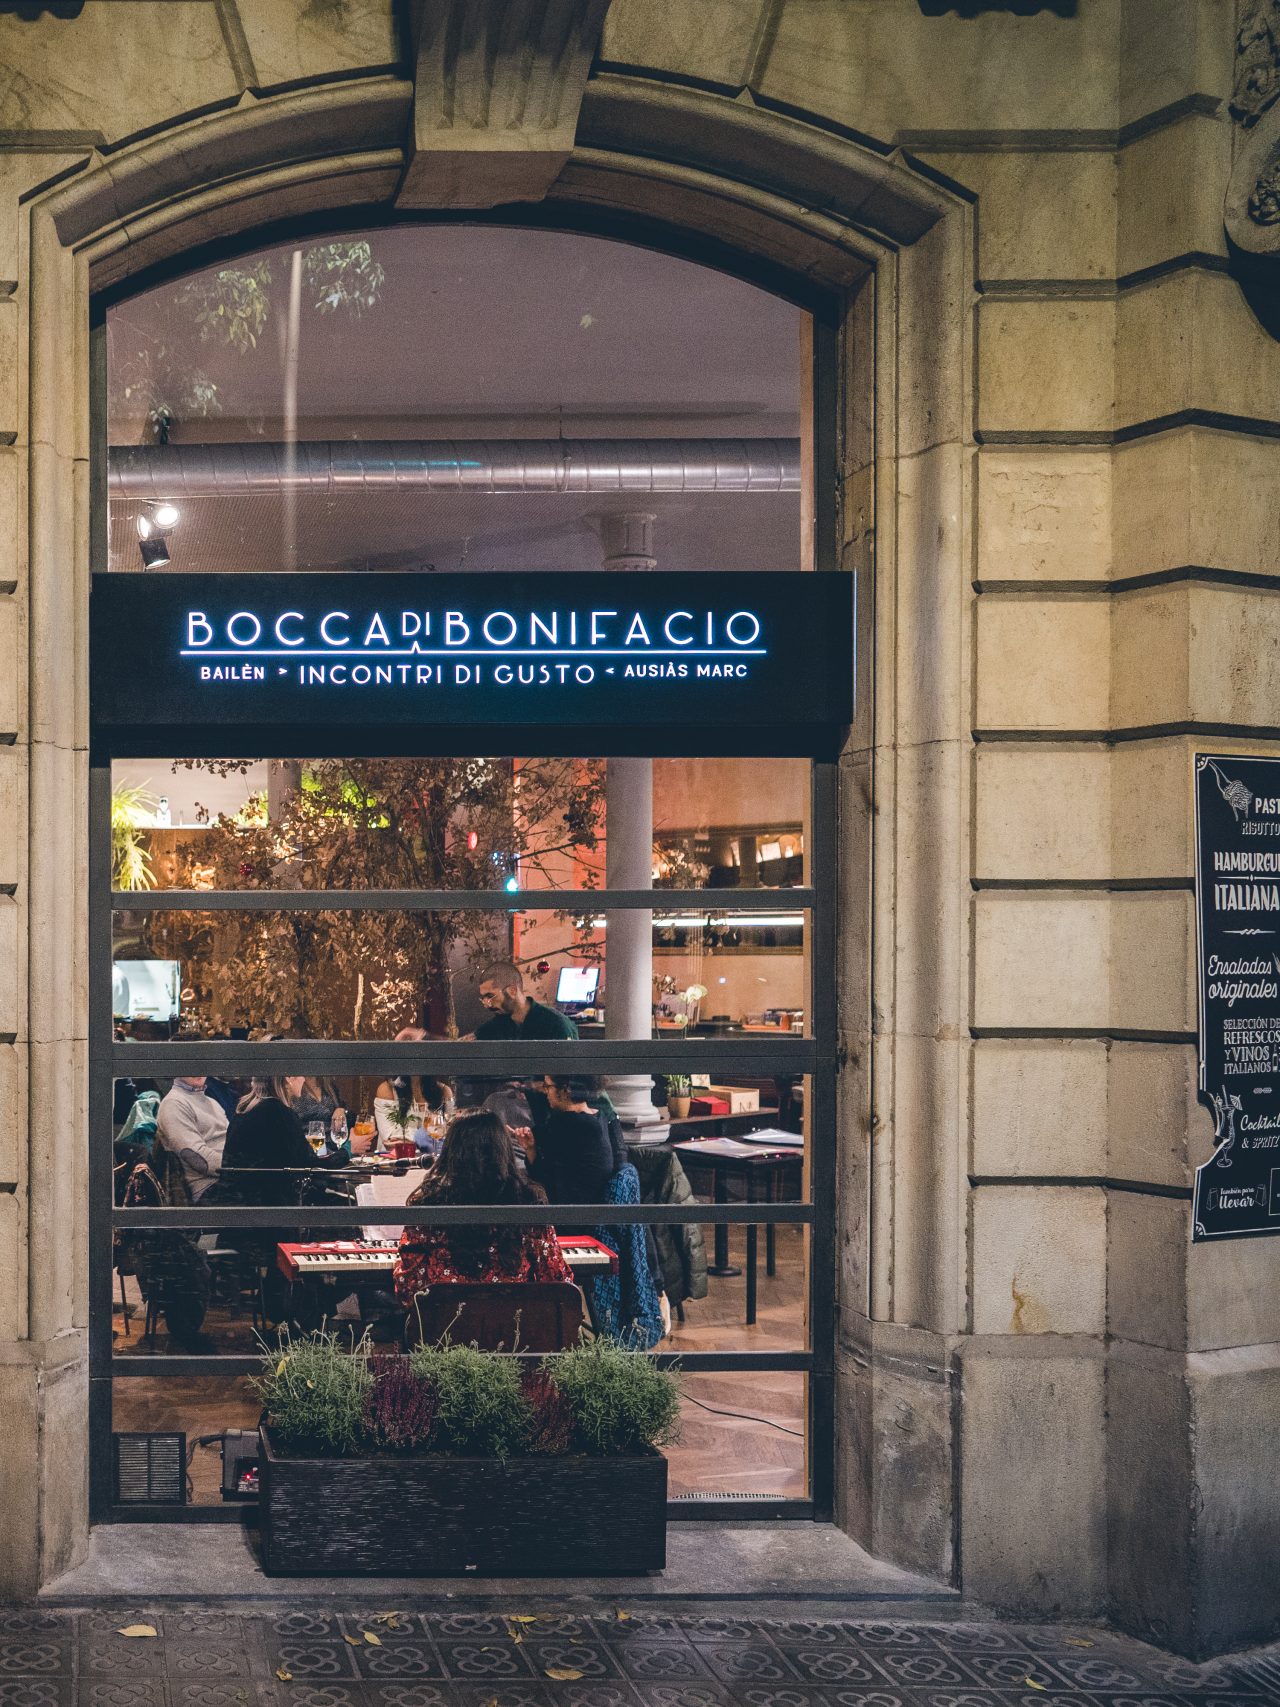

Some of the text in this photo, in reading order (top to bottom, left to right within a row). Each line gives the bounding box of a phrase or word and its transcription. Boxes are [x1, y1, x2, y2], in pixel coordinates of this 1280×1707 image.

[187, 611, 760, 646] BOCCA DI BONIFACIO
[200, 661, 748, 685] BAILÈN INCONTRI DI GUSTO AUSIÀS MARC
[1214, 884, 1280, 911] ITALIANA
[1208, 954, 1272, 977] Ensaladas
[1208, 979, 1278, 1008] originales
[1223, 1016, 1268, 1030] SELECCIÓN
[1223, 1030, 1280, 1045] REFRESCOS
[1231, 1046, 1270, 1062] VINOS
[1223, 1062, 1271, 1075] ITALIANOS
[1241, 1138, 1249, 1149] &
[1219, 1195, 1255, 1209] llevar
